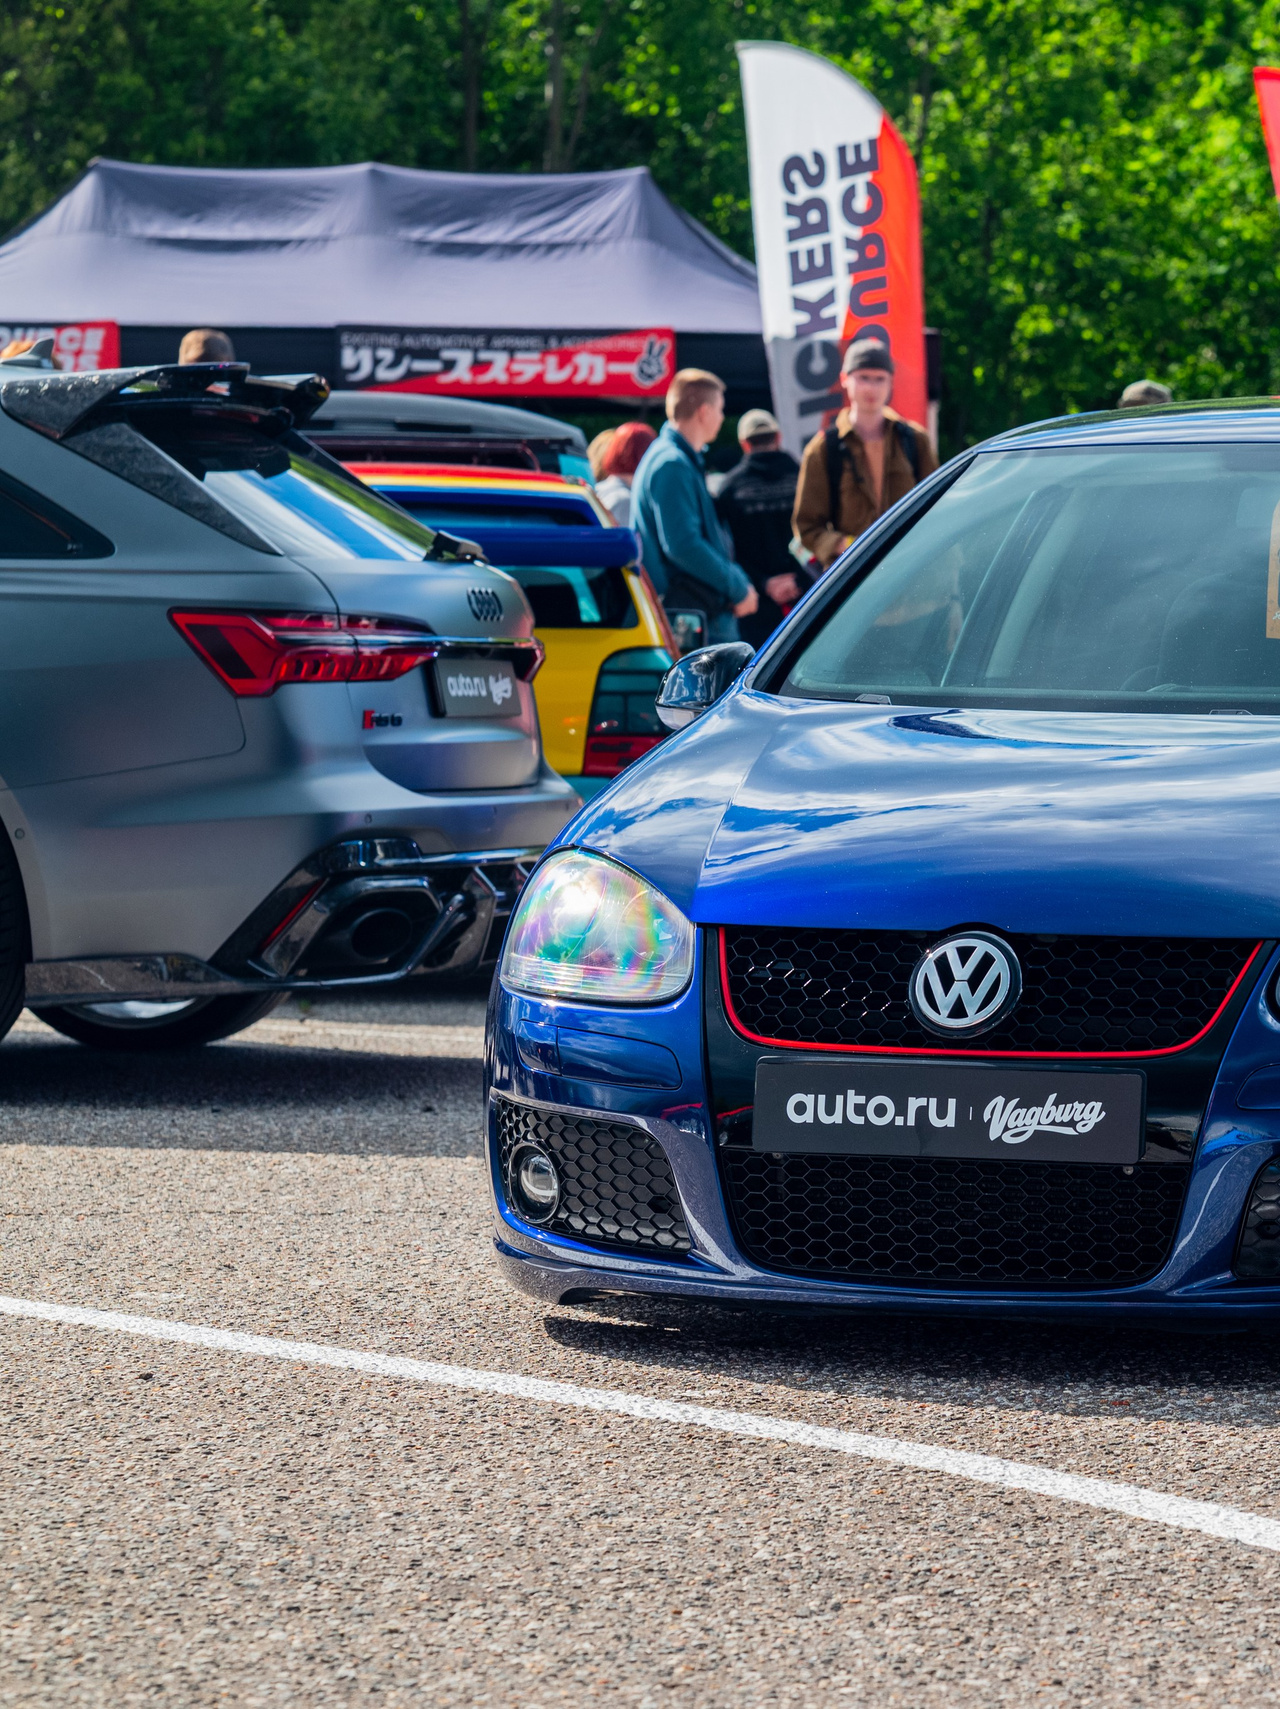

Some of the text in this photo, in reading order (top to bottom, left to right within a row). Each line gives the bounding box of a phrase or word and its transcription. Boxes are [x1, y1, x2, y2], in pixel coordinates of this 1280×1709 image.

[447, 672, 488, 697] auto.ru
[786, 1089, 1106, 1144] auto.ru Vagburg
